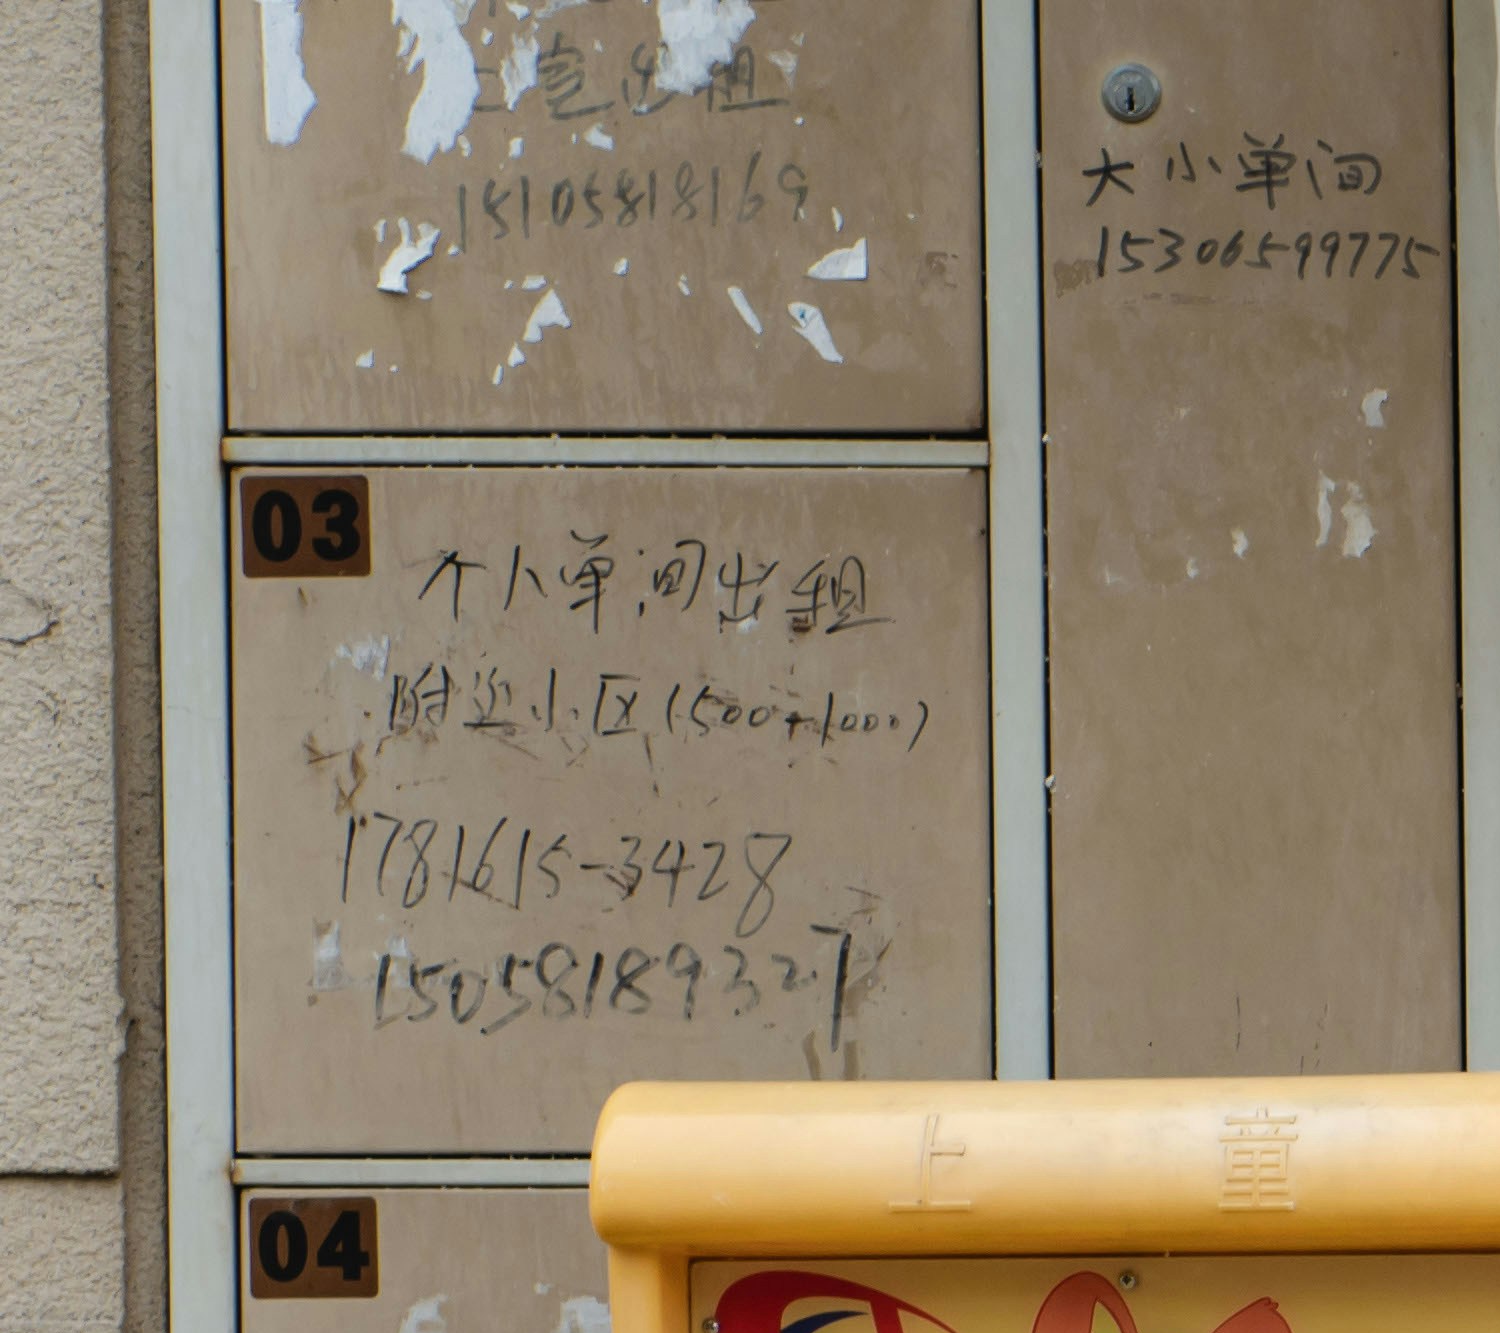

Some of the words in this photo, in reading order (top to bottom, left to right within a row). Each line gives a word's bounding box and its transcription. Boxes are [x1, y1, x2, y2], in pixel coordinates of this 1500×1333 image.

[1083, 132, 1382, 209] 大小单间
[1097, 226, 1440, 280] 15306599775
[251, 490, 361, 564] 03
[258, 1210, 370, 1283] 04
